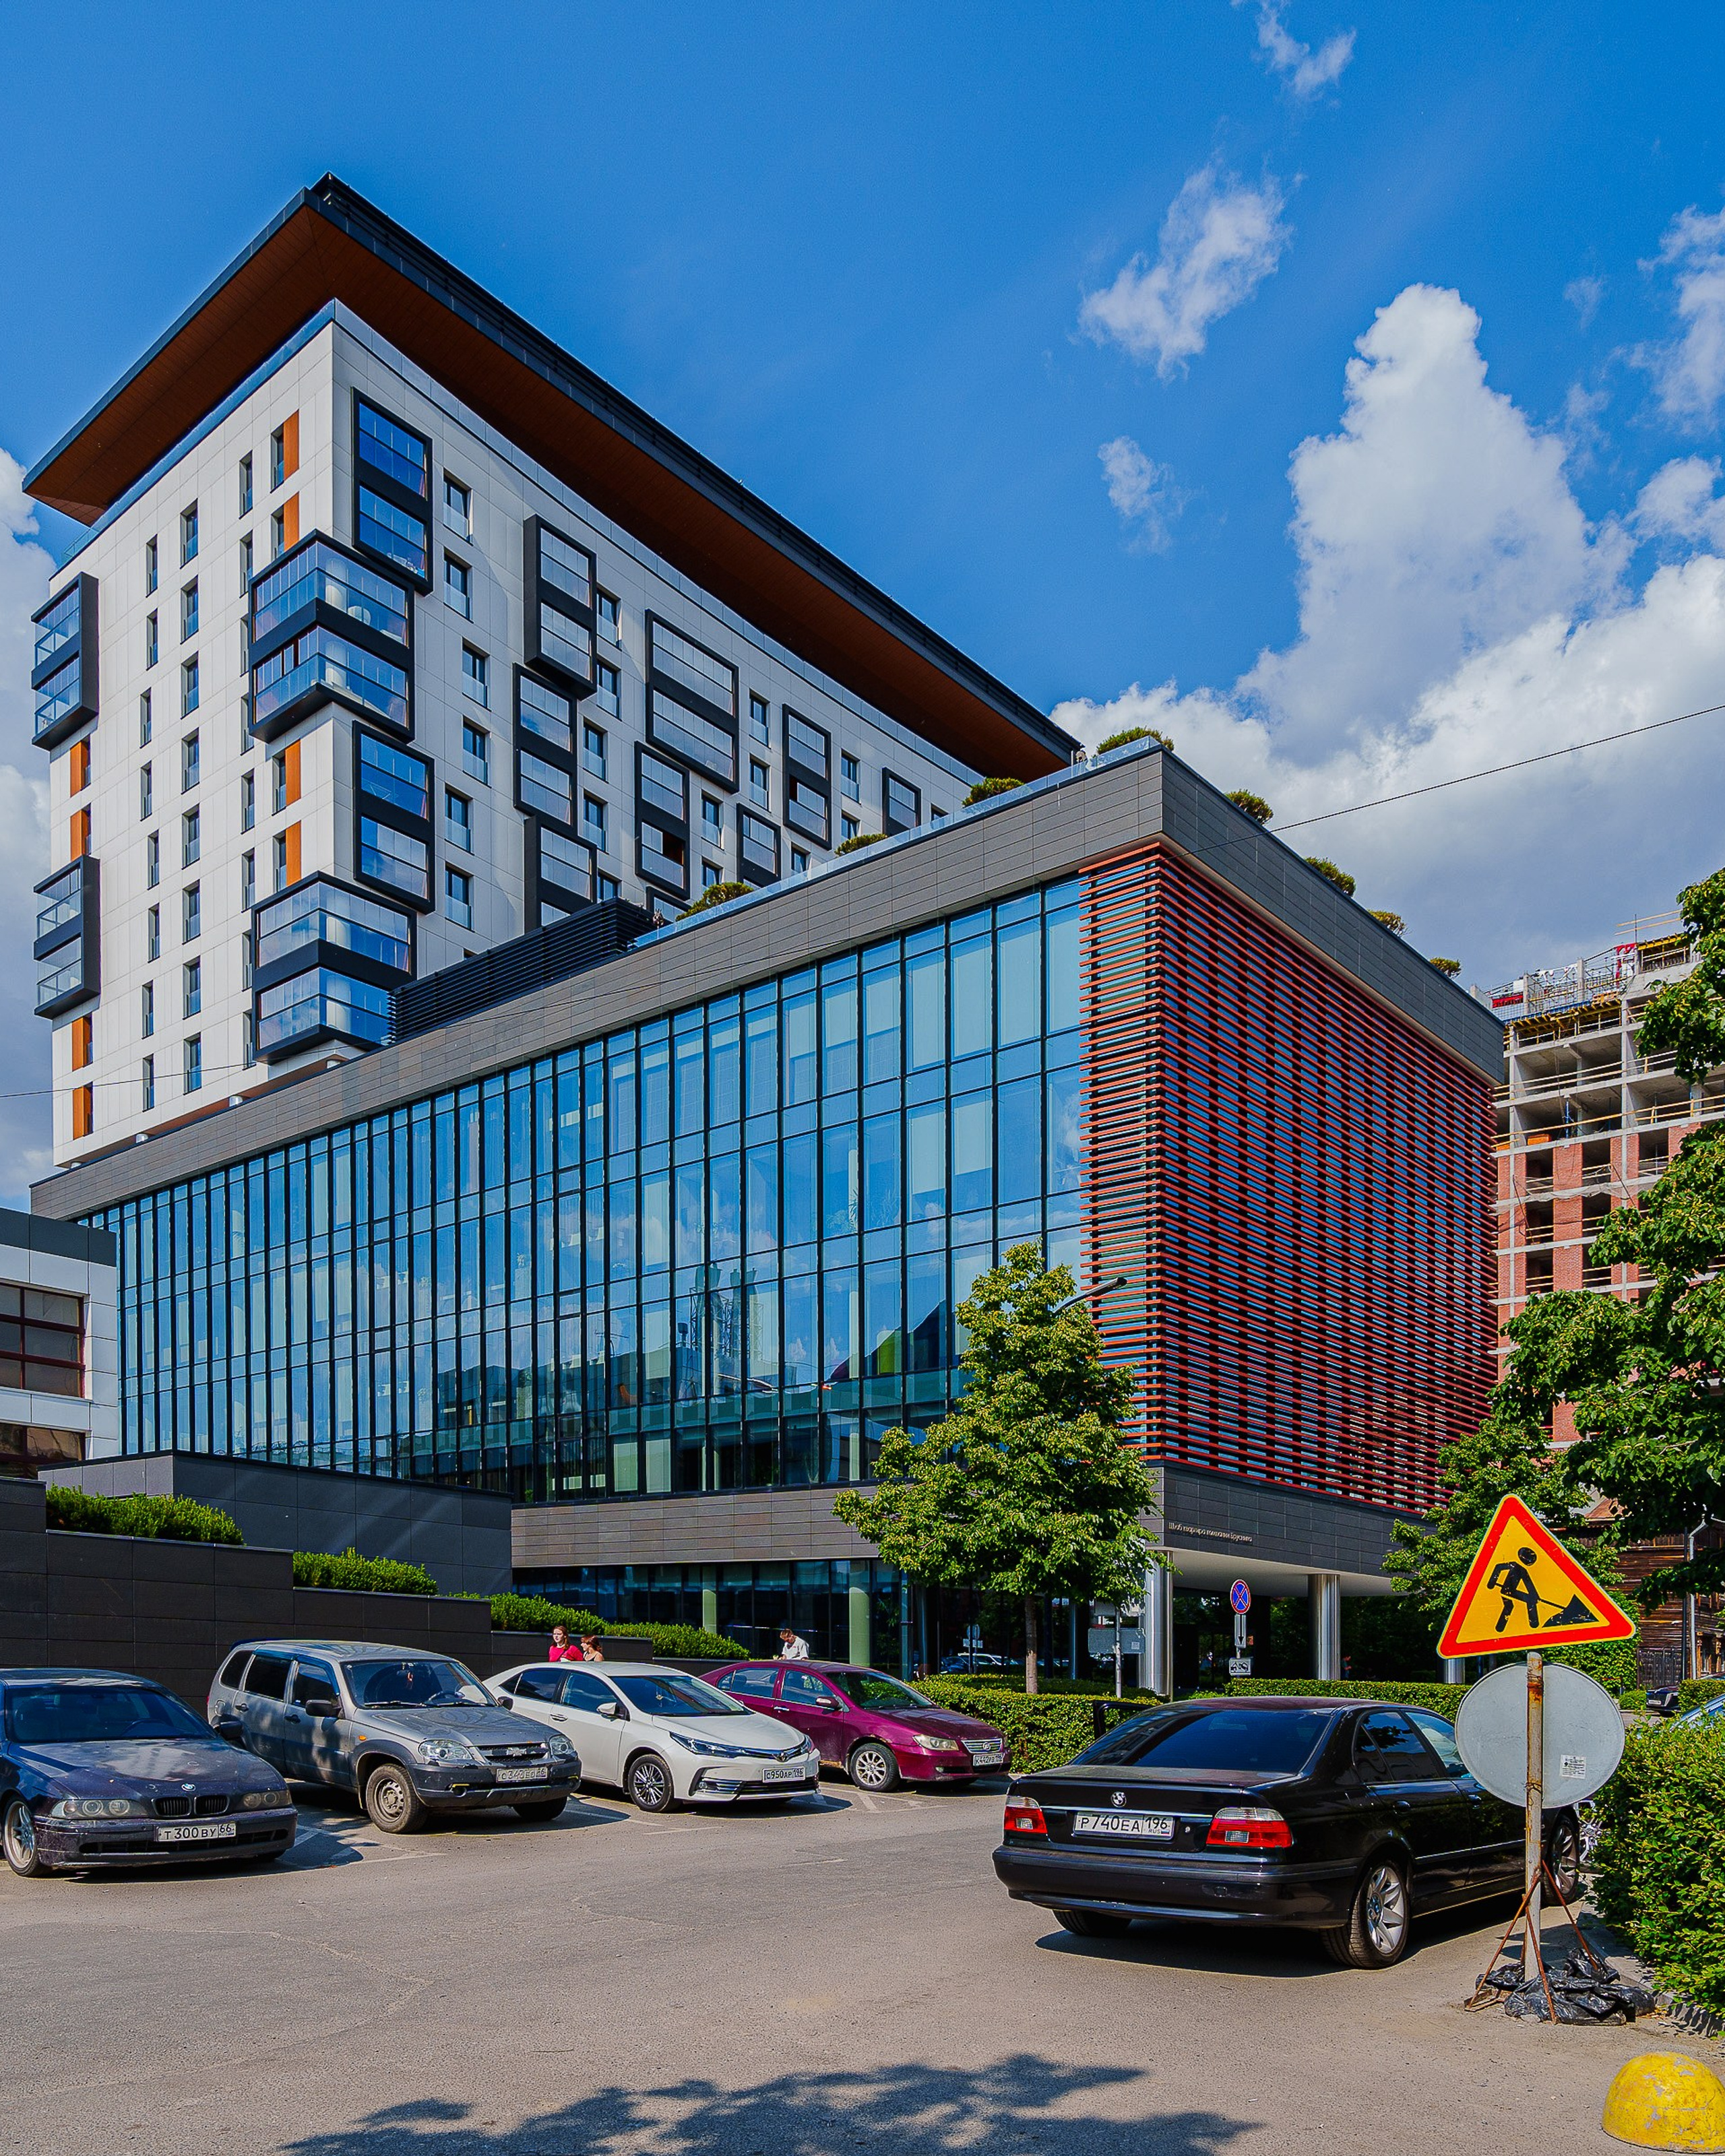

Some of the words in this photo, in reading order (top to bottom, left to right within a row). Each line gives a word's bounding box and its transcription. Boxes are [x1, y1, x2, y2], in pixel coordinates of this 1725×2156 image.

[766, 1770, 792, 1779] С950АР
[164, 1827, 216, 1840] Т300ВУ
[219, 1823, 231, 1833] 66
[1081, 1814, 1140, 1832] Р740ЕА
[1146, 1817, 1168, 1829] 196
